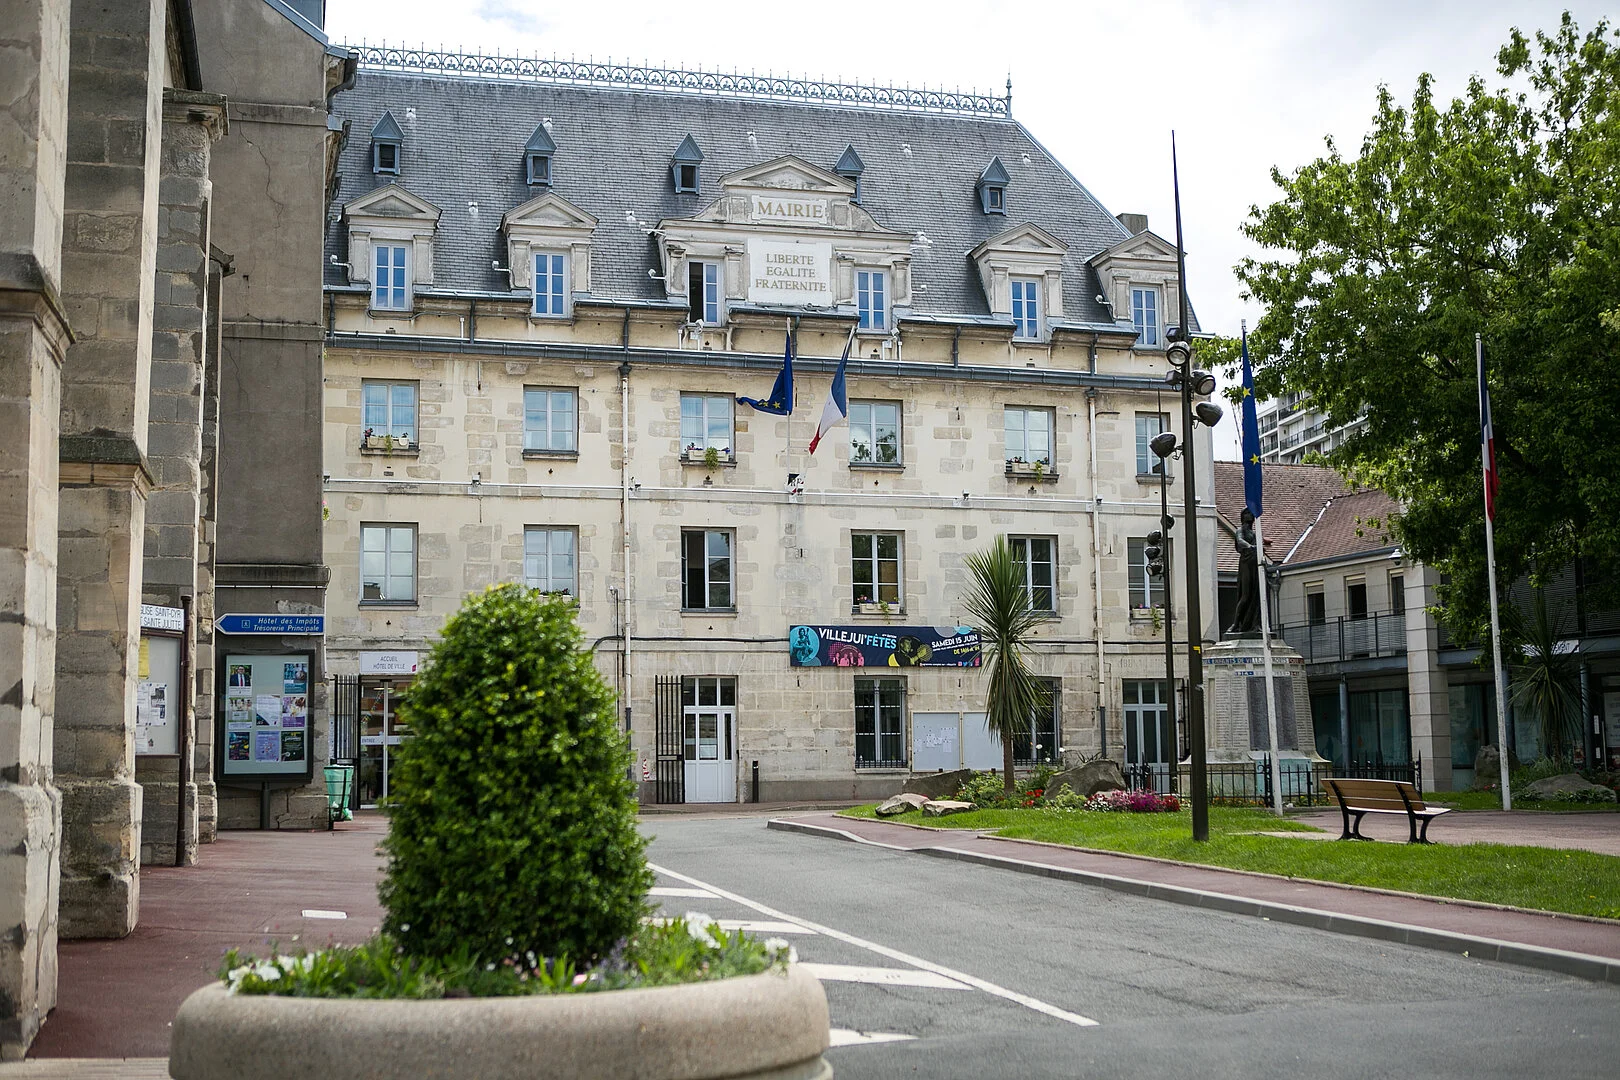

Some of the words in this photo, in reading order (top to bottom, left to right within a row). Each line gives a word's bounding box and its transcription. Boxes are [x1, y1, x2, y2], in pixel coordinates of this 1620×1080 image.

[758, 201, 824, 218] MAIRIE
[766, 253, 815, 265] LIBERTE
[766, 266, 816, 278] EGALITE
[755, 279, 827, 292] FRATERNITE
[295, 617, 320, 625] Impôts
[931, 638, 955, 649] SAMEDI
[955, 636, 962, 644] 15
[963, 634, 978, 643] JUIN
